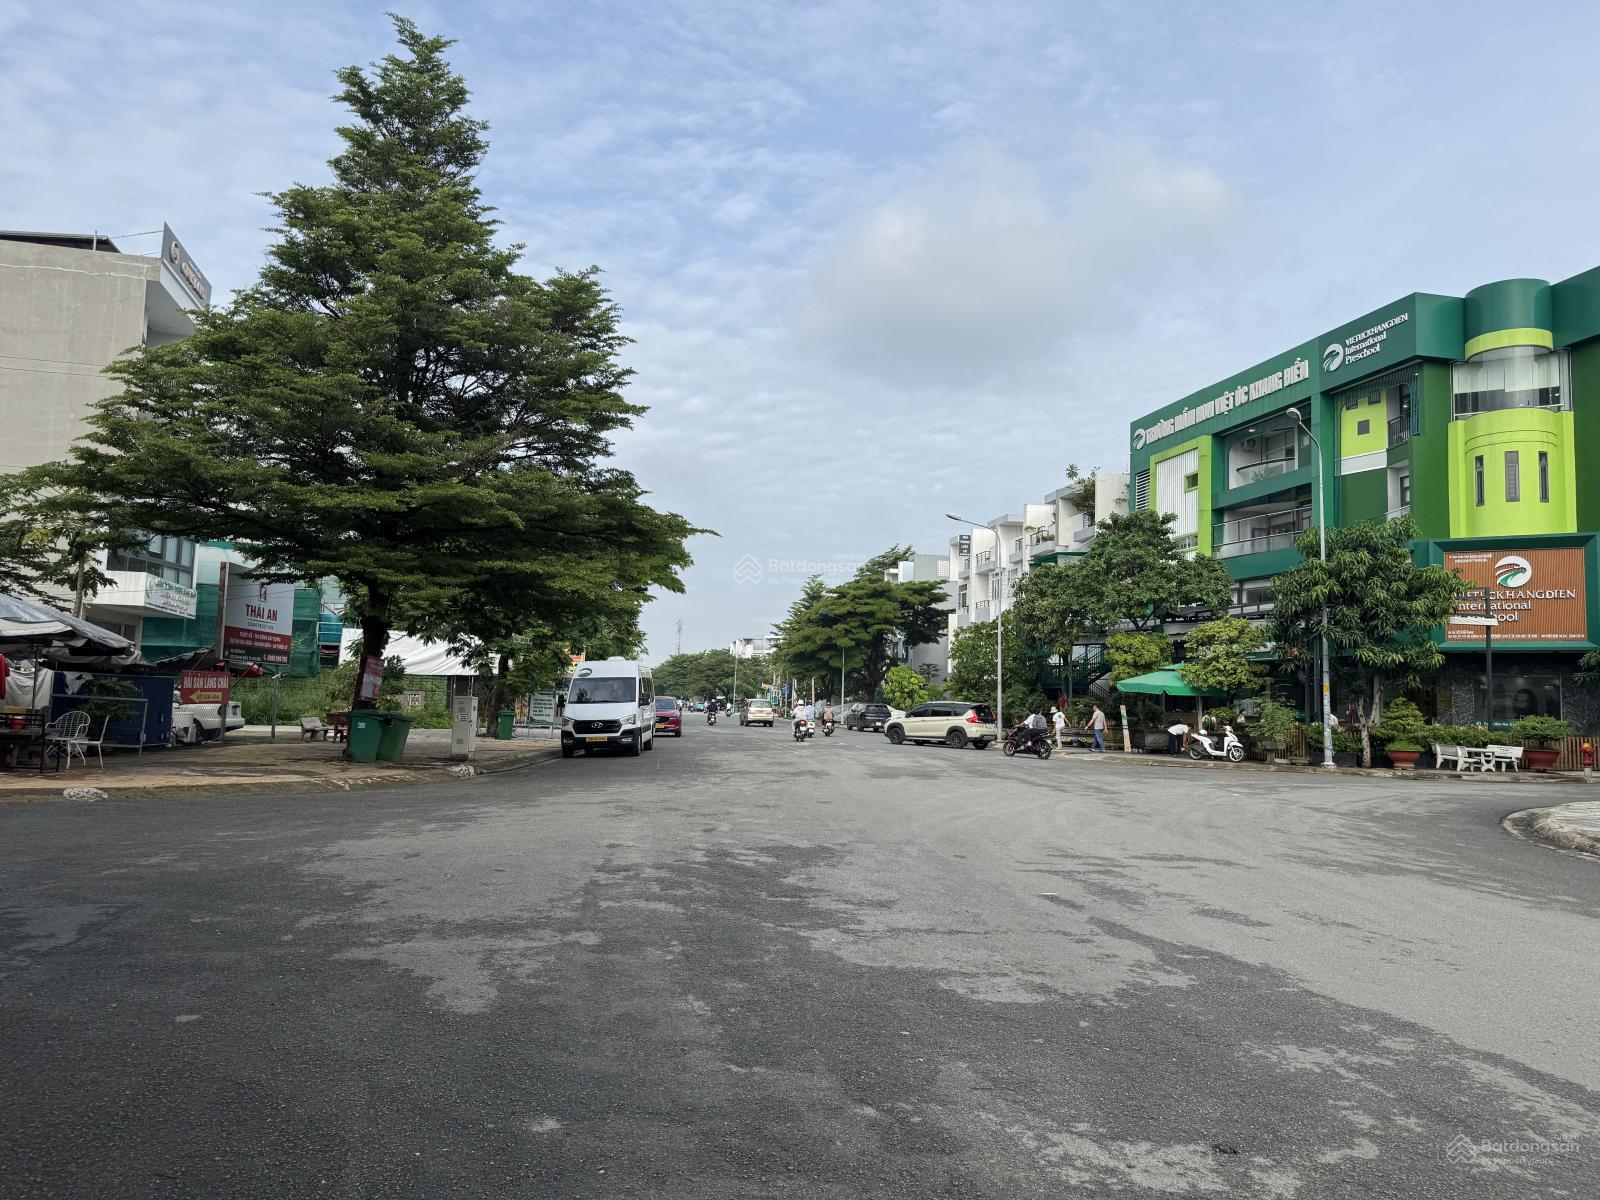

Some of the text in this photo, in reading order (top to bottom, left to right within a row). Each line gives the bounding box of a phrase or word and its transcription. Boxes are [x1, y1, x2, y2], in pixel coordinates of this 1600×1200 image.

[1345, 331, 1386, 355] International
[1345, 343, 1380, 364] Preschool
[245, 603, 278, 622] THÁI AN
[1457, 600, 1532, 611] nterational
